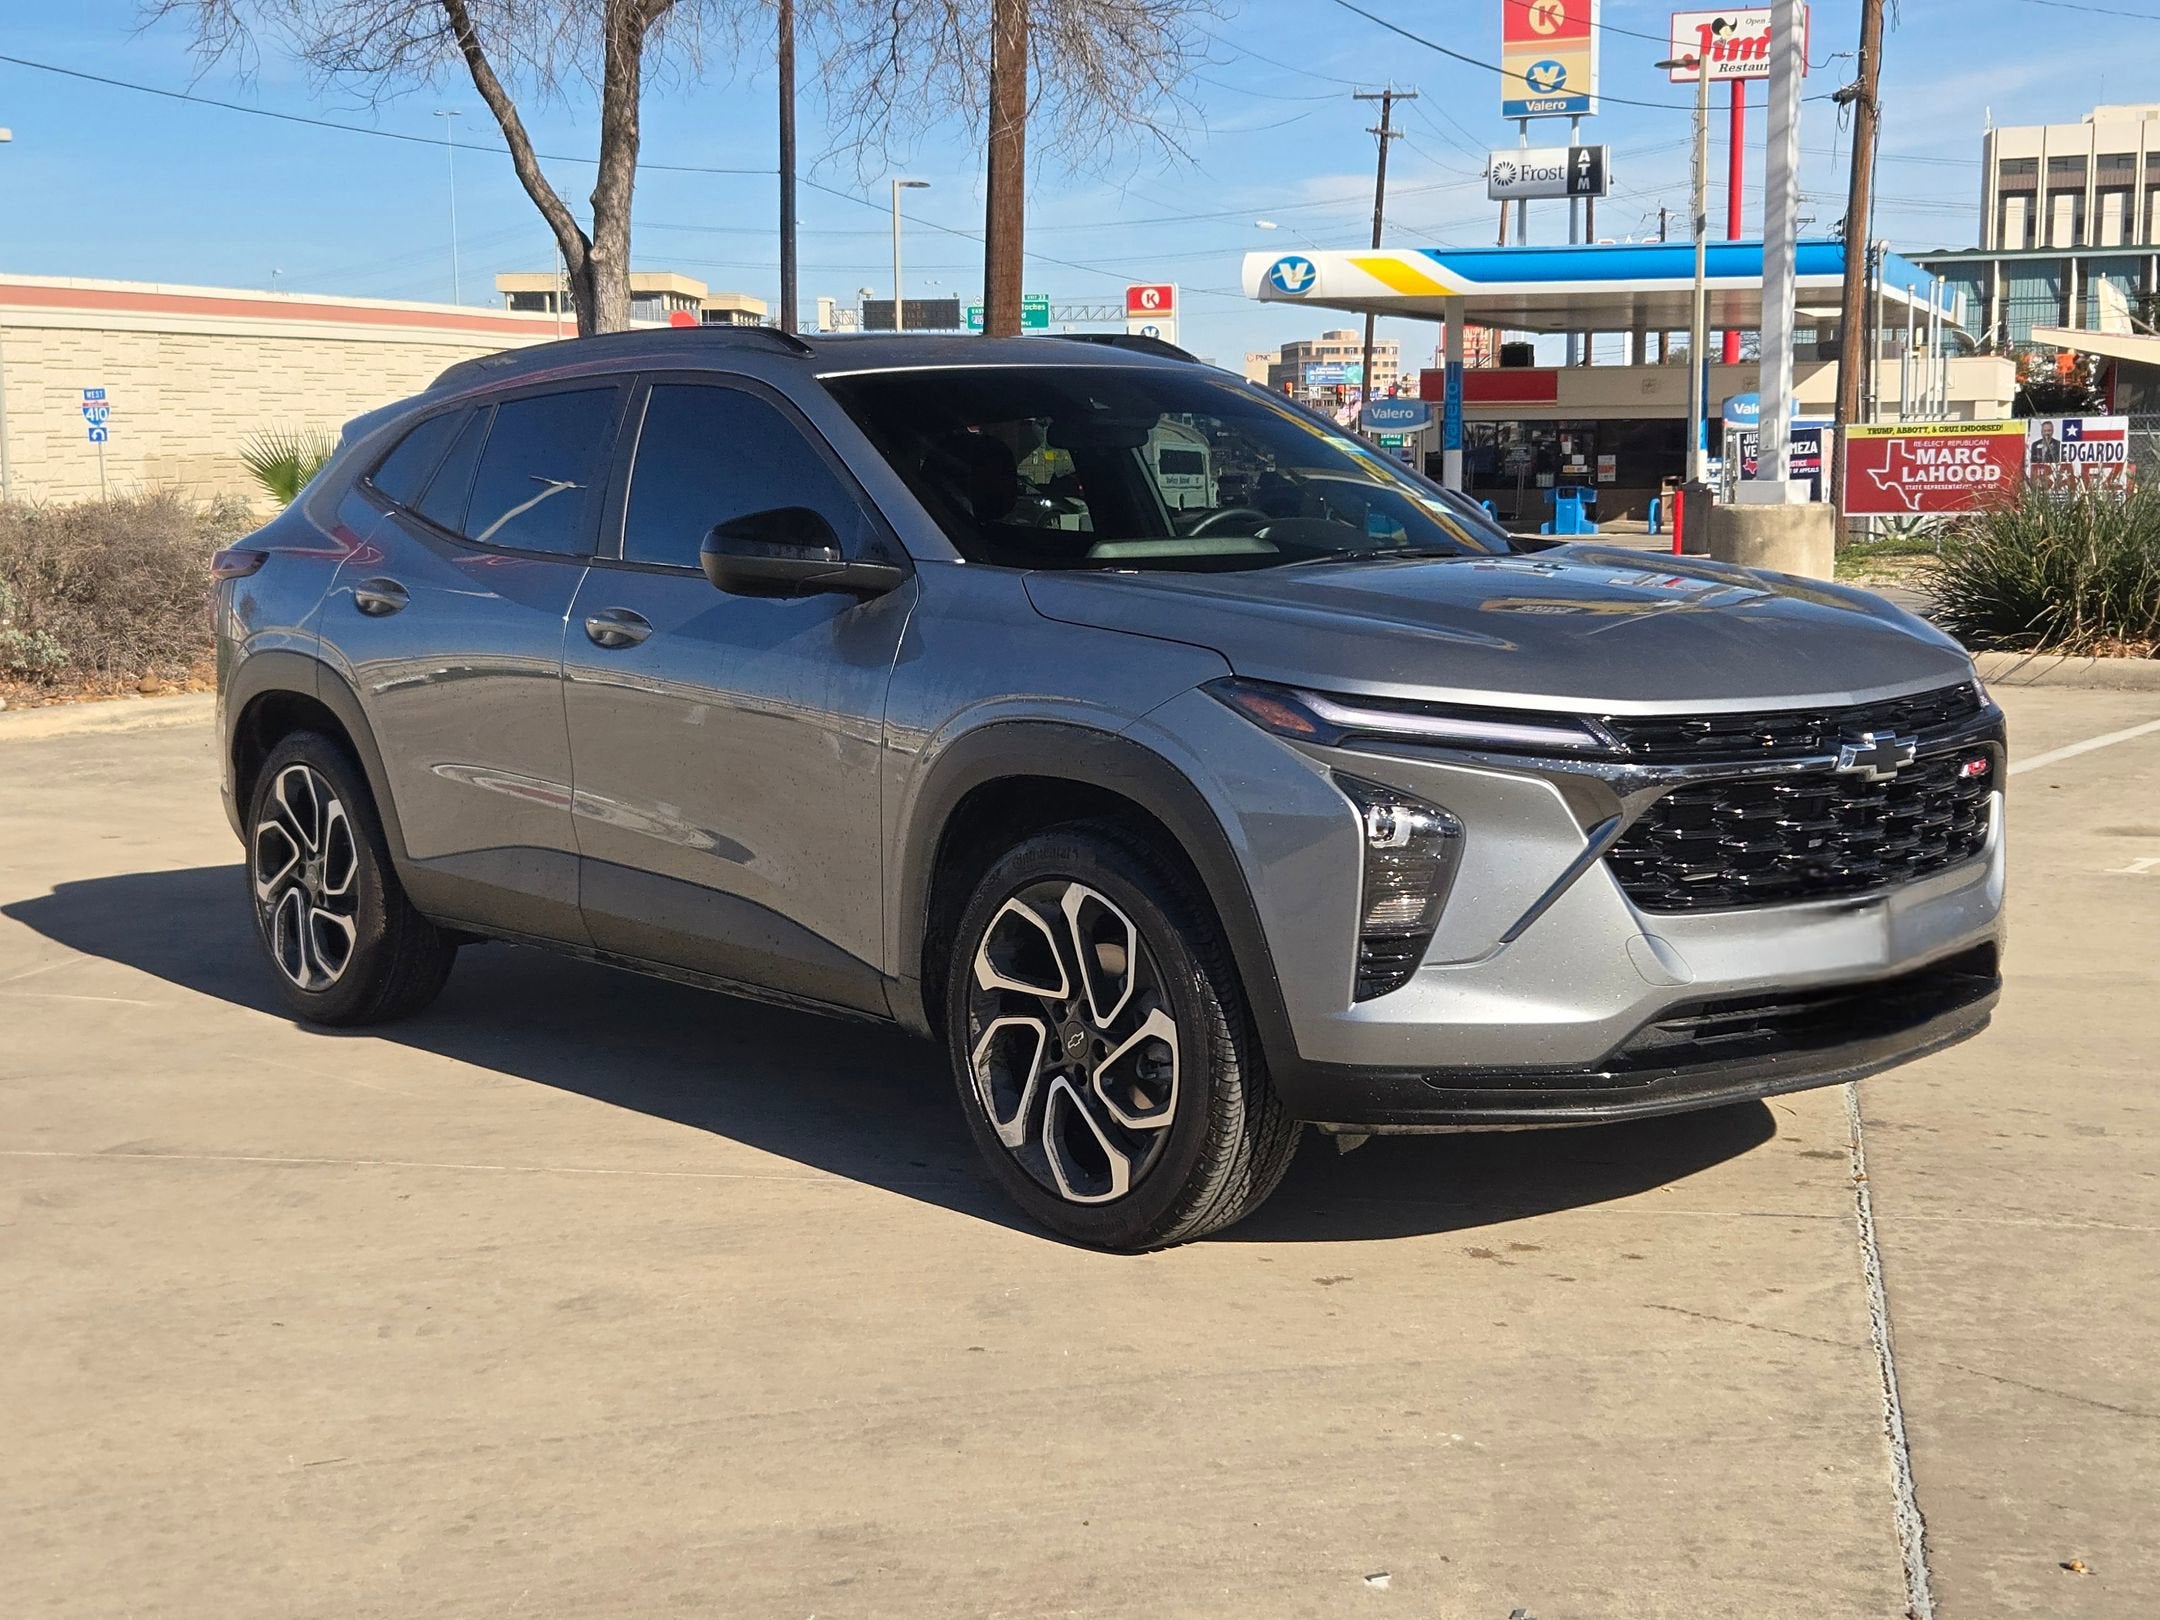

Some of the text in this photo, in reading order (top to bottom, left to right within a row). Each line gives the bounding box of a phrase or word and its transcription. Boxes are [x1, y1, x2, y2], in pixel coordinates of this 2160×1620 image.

[1745, 18, 1766, 26] Open
[1718, 63, 1770, 72] Restaur
[1526, 101, 1567, 112] Valero
[1520, 164, 1565, 182] Frost
[1577, 149, 1591, 190] ATM
[86, 391, 104, 399] WEST
[86, 407, 108, 421] 410
[1371, 408, 1414, 419] Valero
[1734, 403, 1760, 415] Val
[1867, 427, 1895, 435] TRUMP,
[1896, 426, 1930, 435] ABBOTT,
[1938, 425, 1959, 433] CRUZ
[1960, 424, 2003, 433] ENDORSED!
[1947, 439, 1990, 447] REPUBLICAN
[1916, 447, 1987, 465] MARC
[2061, 443, 2124, 462] EDGARDO
